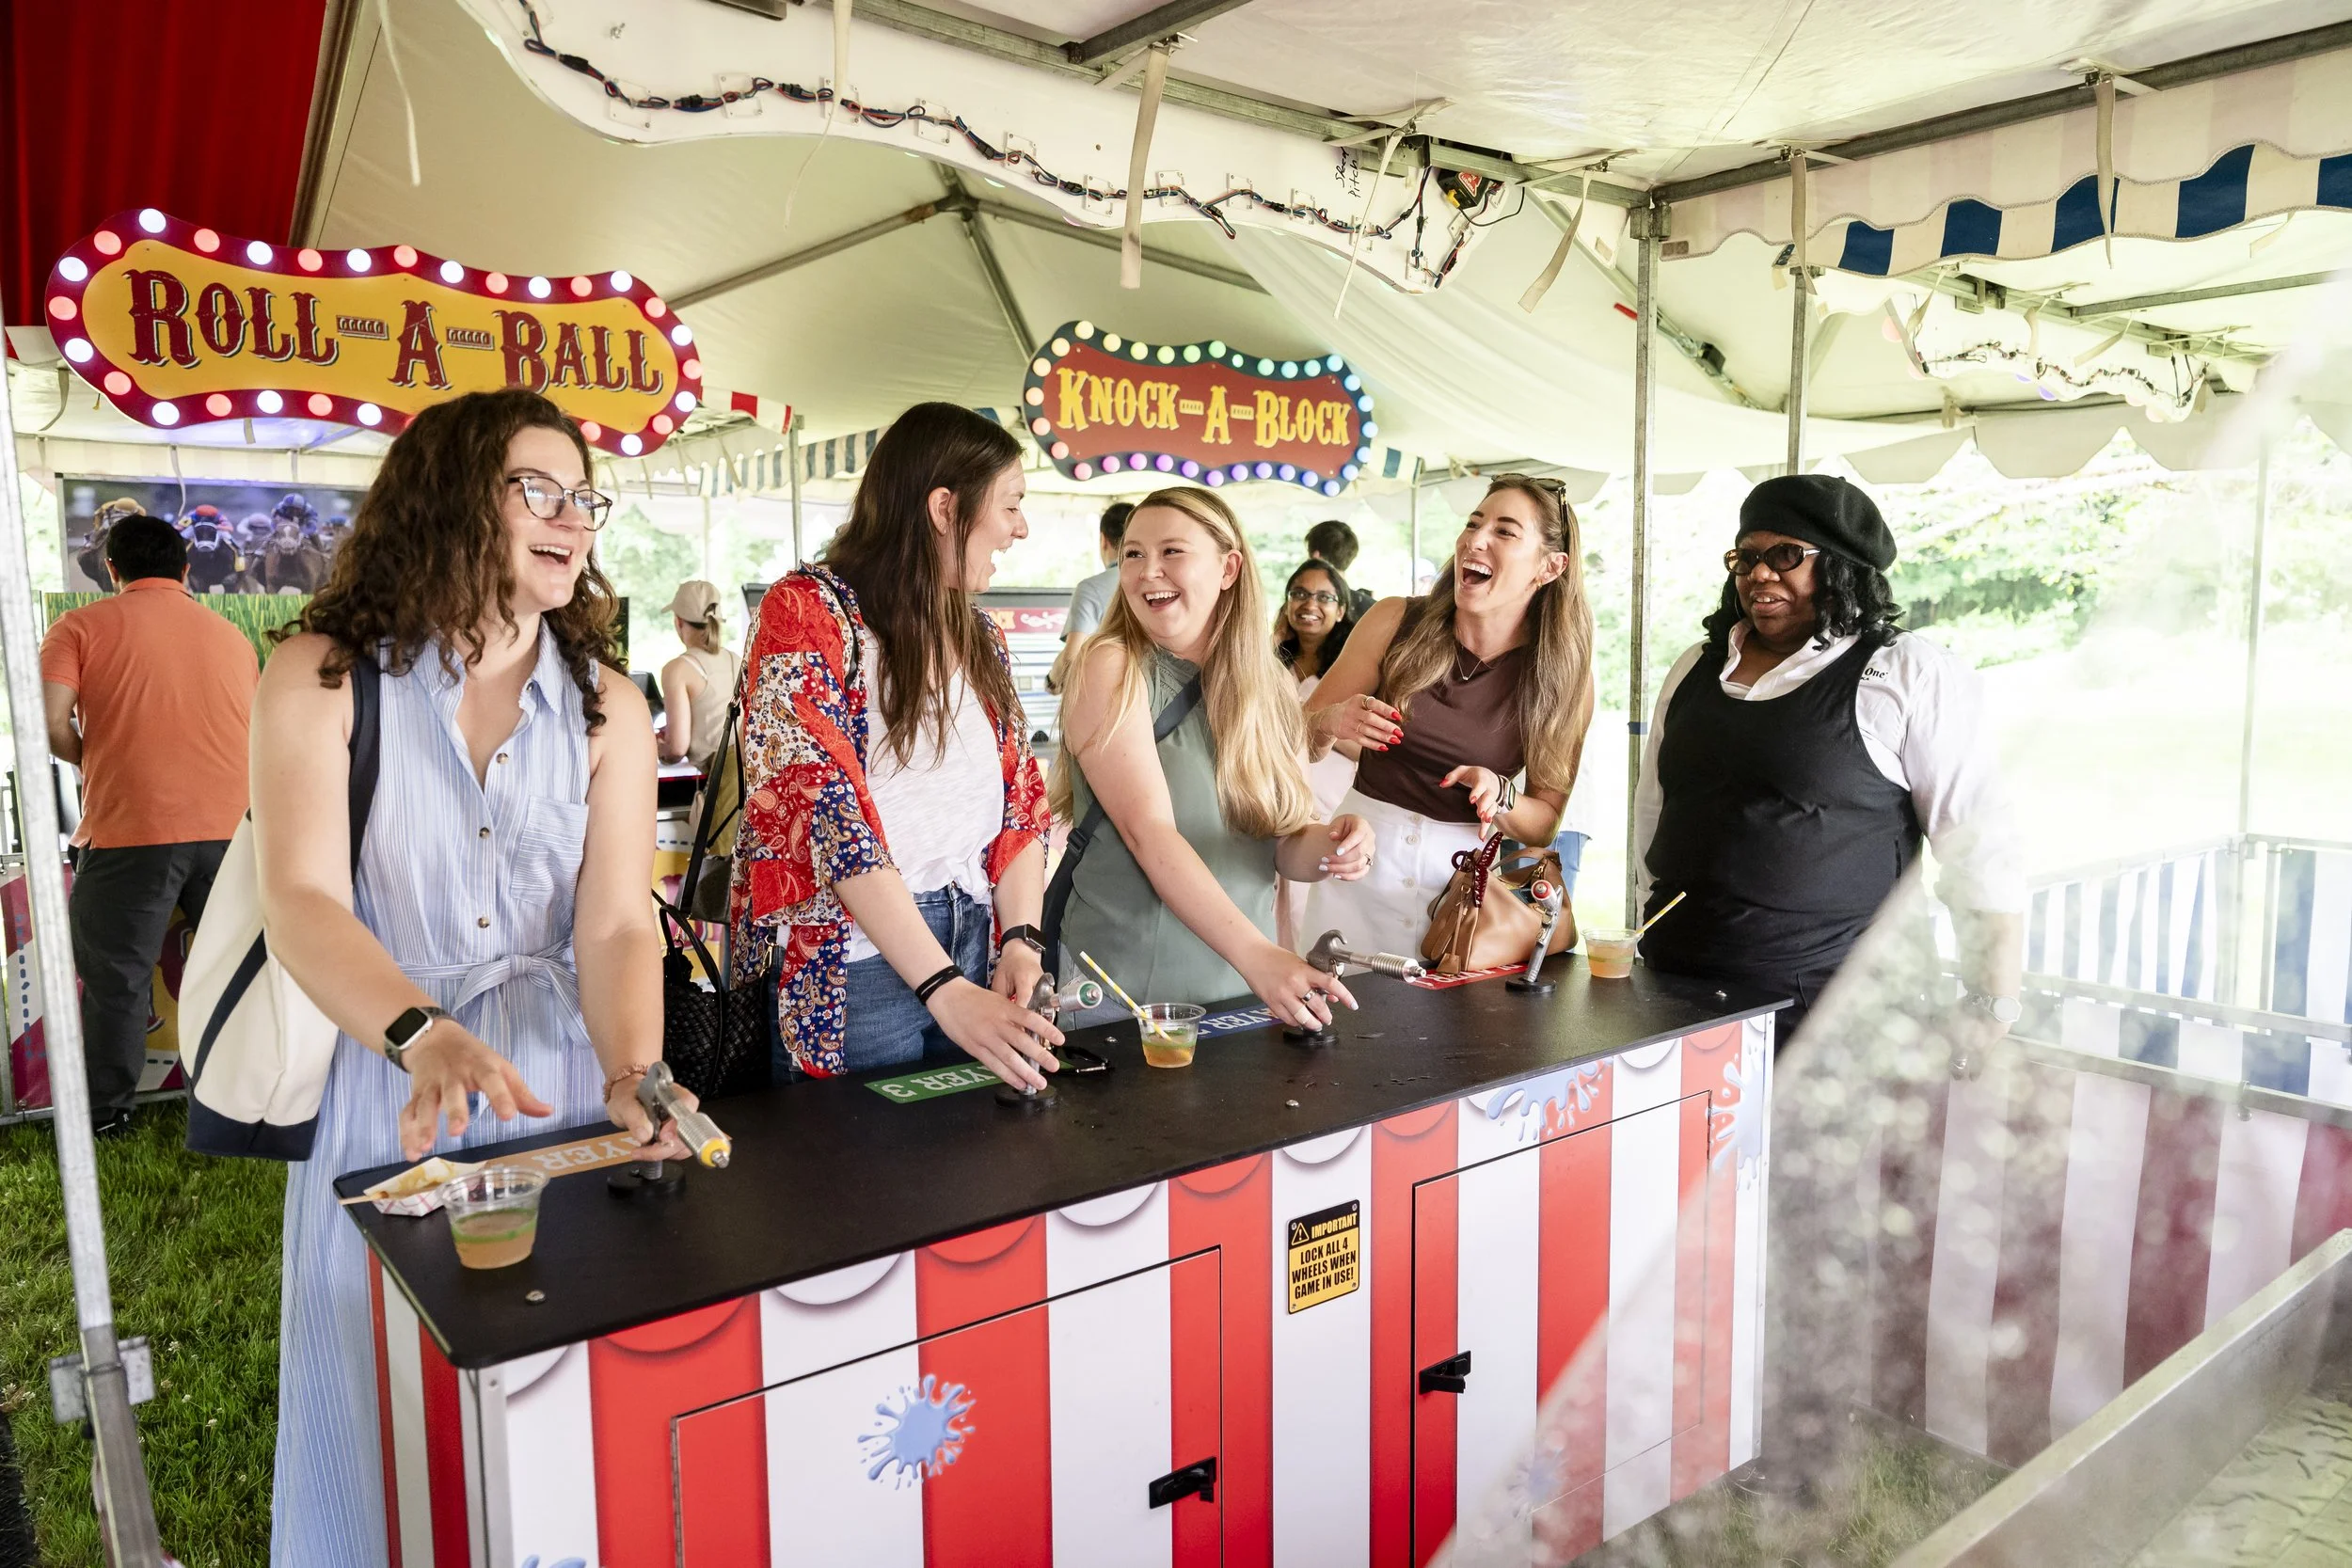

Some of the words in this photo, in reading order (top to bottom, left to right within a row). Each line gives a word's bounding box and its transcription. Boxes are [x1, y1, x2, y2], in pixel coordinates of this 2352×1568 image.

[881, 1084, 917, 1098] 3
[1311, 1212, 1358, 1239] IMPORTANT
[1300, 1244, 1324, 1265] LOCK
[1326, 1240, 1341, 1257] ALL
[1343, 1237, 1348, 1250] 4
[1292, 1260, 1327, 1284] WHEELS
[1330, 1250, 1356, 1271] WHEN
[1295, 1278, 1320, 1300] GAME
[1322, 1274, 1332, 1290] IN
[1334, 1266, 1354, 1286] USE!
